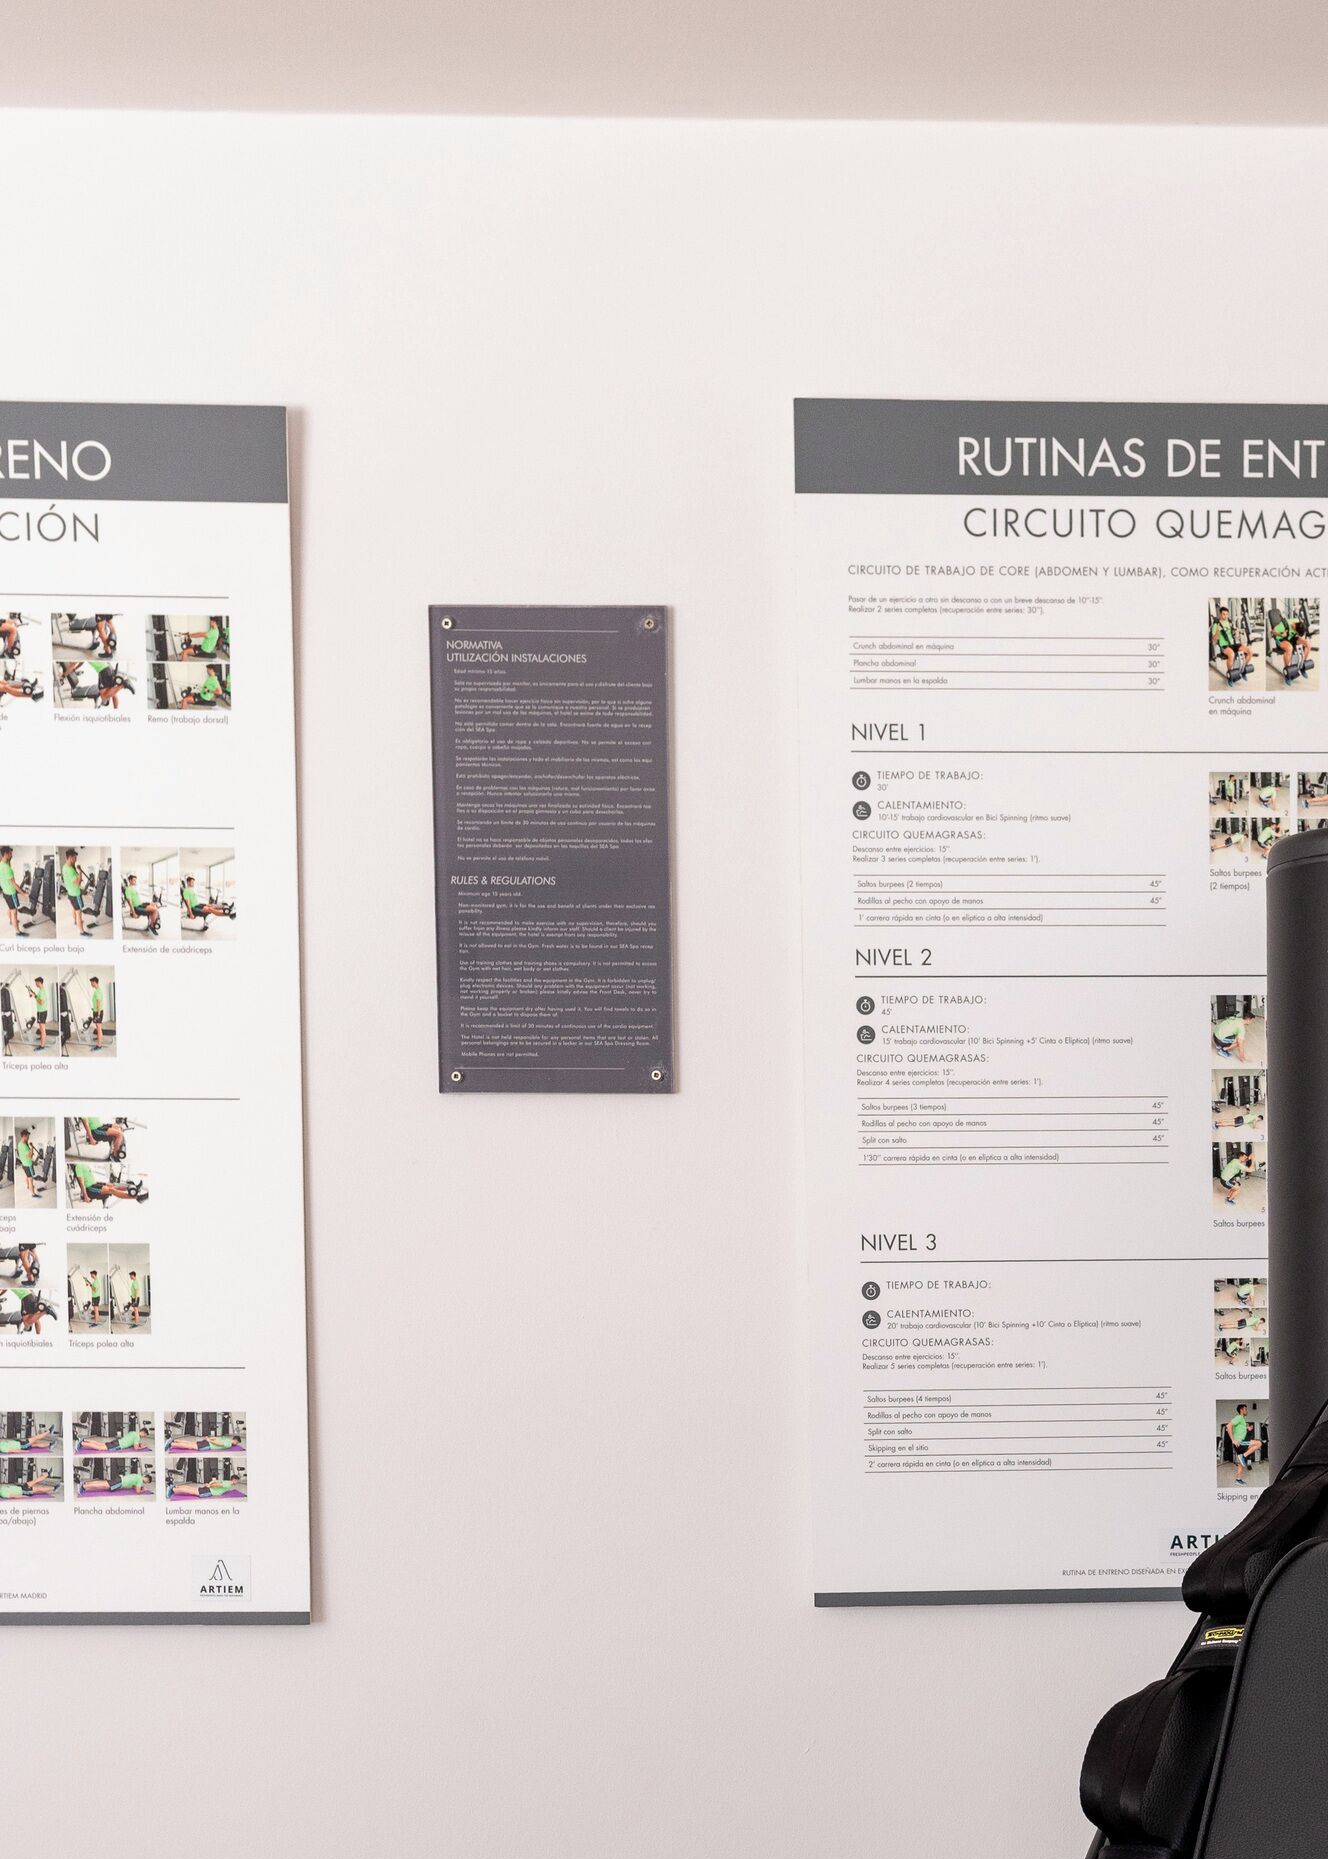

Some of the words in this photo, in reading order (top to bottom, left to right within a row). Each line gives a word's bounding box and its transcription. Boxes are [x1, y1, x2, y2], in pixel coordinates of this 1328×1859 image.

[959, 436, 1146, 478] RUTINAS
[1167, 438, 1221, 478] DE
[964, 508, 1136, 538] CIRCUITO
[848, 565, 901, 576] CIRCUITO
[906, 565, 919, 576] DE
[925, 565, 975, 577] TRABAJO
[980, 565, 994, 576] DE
[999, 565, 1029, 576] CORE
[1035, 566, 1098, 578] (ABDOMEN
[1103, 567, 1109, 577] Y
[1114, 567, 1165, 579] LUMBAR),
[1171, 567, 1209, 578] COMO
[1214, 565, 1300, 578] RECUPERACIÓN
[446, 640, 503, 651] NORMATIVA
[447, 651, 508, 663] UTILIZACIÓN
[511, 653, 588, 664] INSTALACIONES
[852, 724, 908, 740] NIVEL
[919, 724, 924, 740] 1
[878, 770, 914, 780] TIEMPO
[919, 770, 930, 780] DE
[936, 770, 984, 780] TRABAJO:
[877, 801, 966, 809] CALENTAMIENTO:
[852, 830, 900, 839] CIRCUITO
[903, 831, 985, 839] QUEMAGRASAS:
[451, 876, 478, 885] RULES
[481, 876, 487, 885] &
[491, 876, 555, 886] REGULATIONS
[856, 948, 912, 966] NIVEL
[921, 948, 931, 966] 2
[882, 996, 918, 1004] TIEMPO
[923, 996, 933, 1004] DE
[940, 995, 987, 1004] TRABAJO:
[882, 1024, 969, 1034] CALENTAMIENTO:
[857, 1054, 903, 1063] CIRCUITO
[908, 1053, 989, 1063] QUEMAGRASAS:
[862, 1234, 917, 1251] NIVEL
[926, 1233, 936, 1251] 3
[887, 1280, 923, 1290] TIEMPO
[928, 1280, 938, 1289] DE
[945, 1280, 992, 1290] TRABAJO:
[887, 1309, 974, 1318] CALENTAMIENTO:
[862, 1338, 908, 1347] CIRCUITO
[913, 1337, 994, 1347] QUEMAGRASAS:
